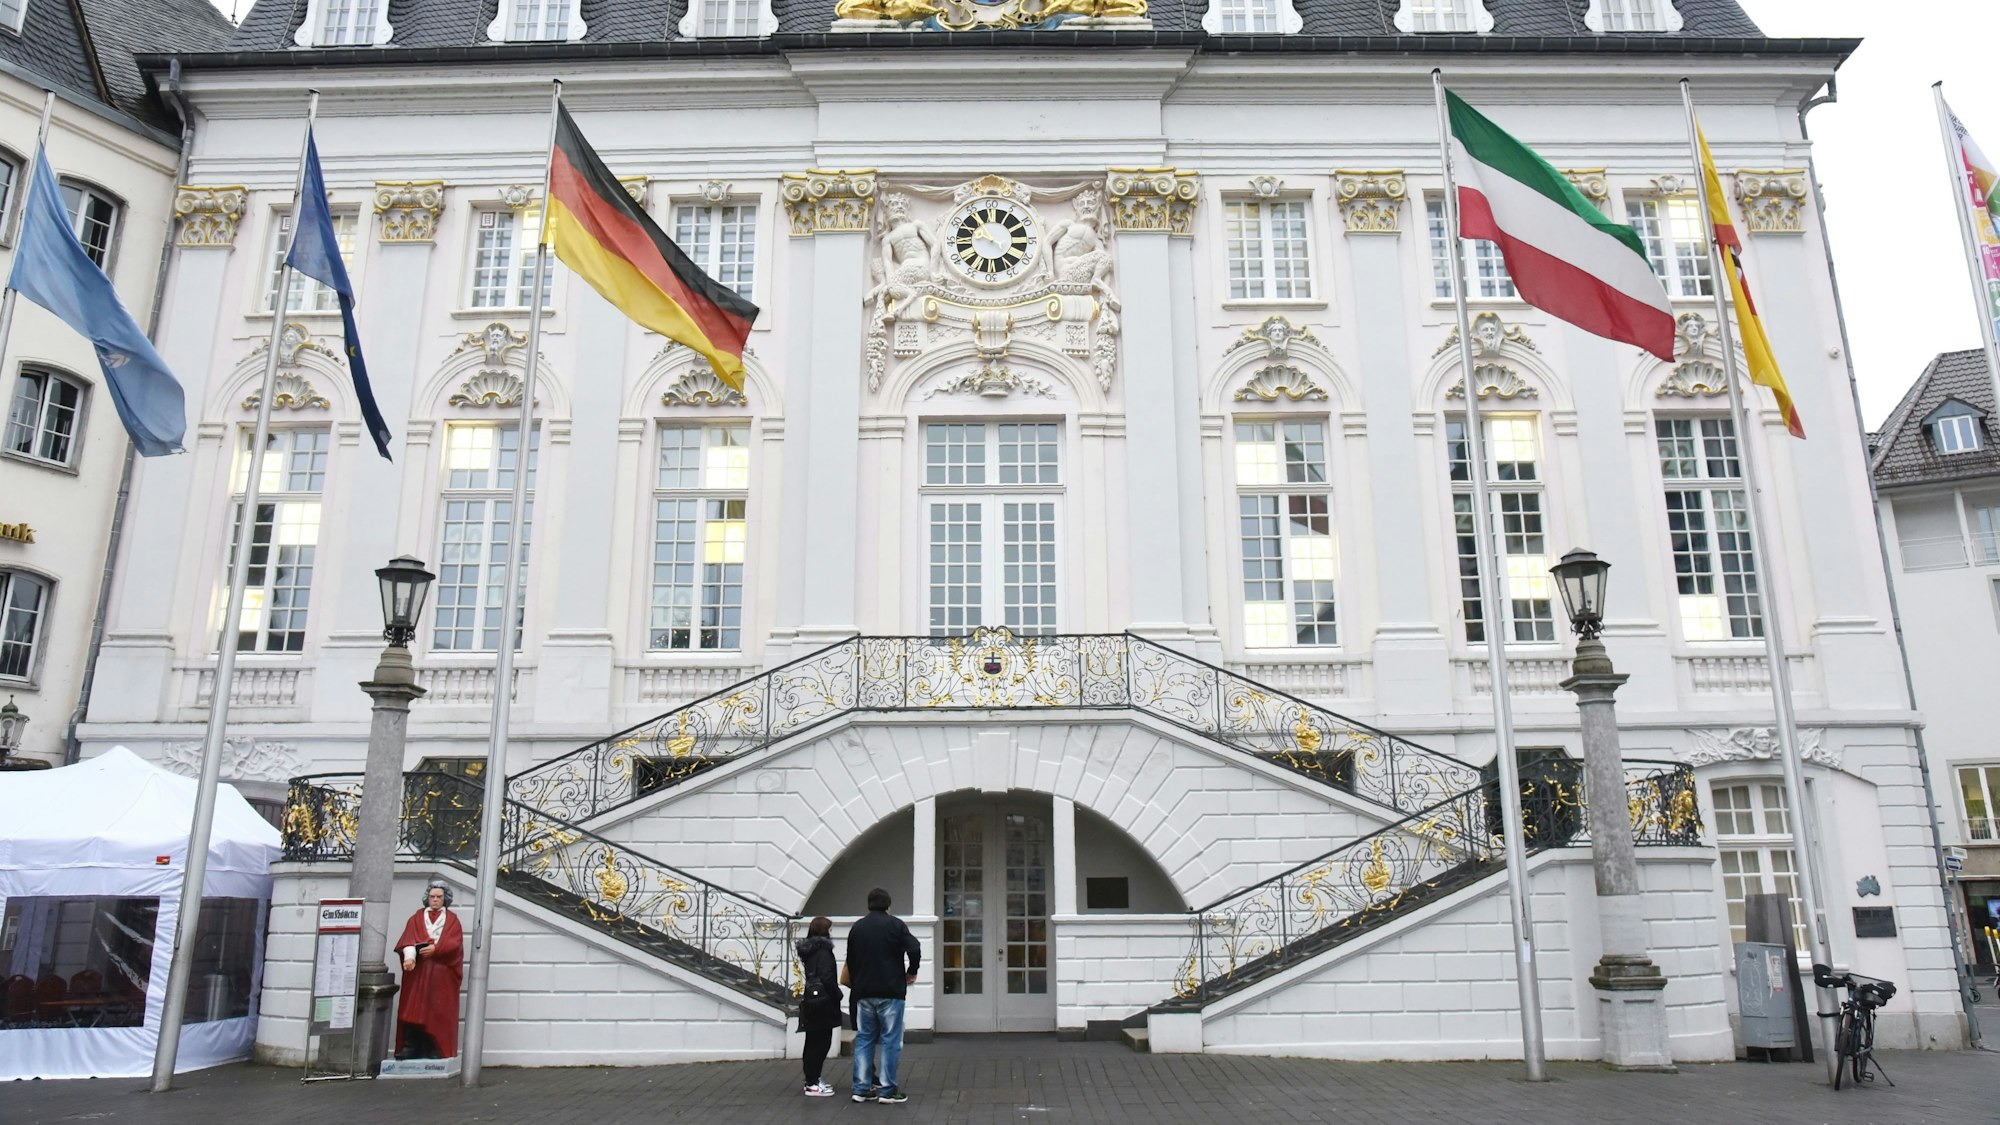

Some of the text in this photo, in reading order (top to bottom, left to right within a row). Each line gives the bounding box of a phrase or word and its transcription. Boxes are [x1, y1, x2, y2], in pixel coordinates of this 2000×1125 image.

[966, 204, 978, 216] 55
[986, 200, 998, 209] 60
[1009, 205, 1016, 213] 5
[951, 217, 962, 229] 50
[1021, 216, 1032, 227] 10
[946, 236, 955, 247] 45
[1028, 236, 1037, 245] 15
[951, 253, 962, 266] 40
[1022, 253, 1033, 265] 20
[965, 267, 977, 279] 35
[985, 273, 998, 282] 30
[1006, 267, 1019, 278] 25
[1659, 445, 1692, 476] 22
[0, 521, 37, 544] nk
[448, 528, 482, 559] 20
